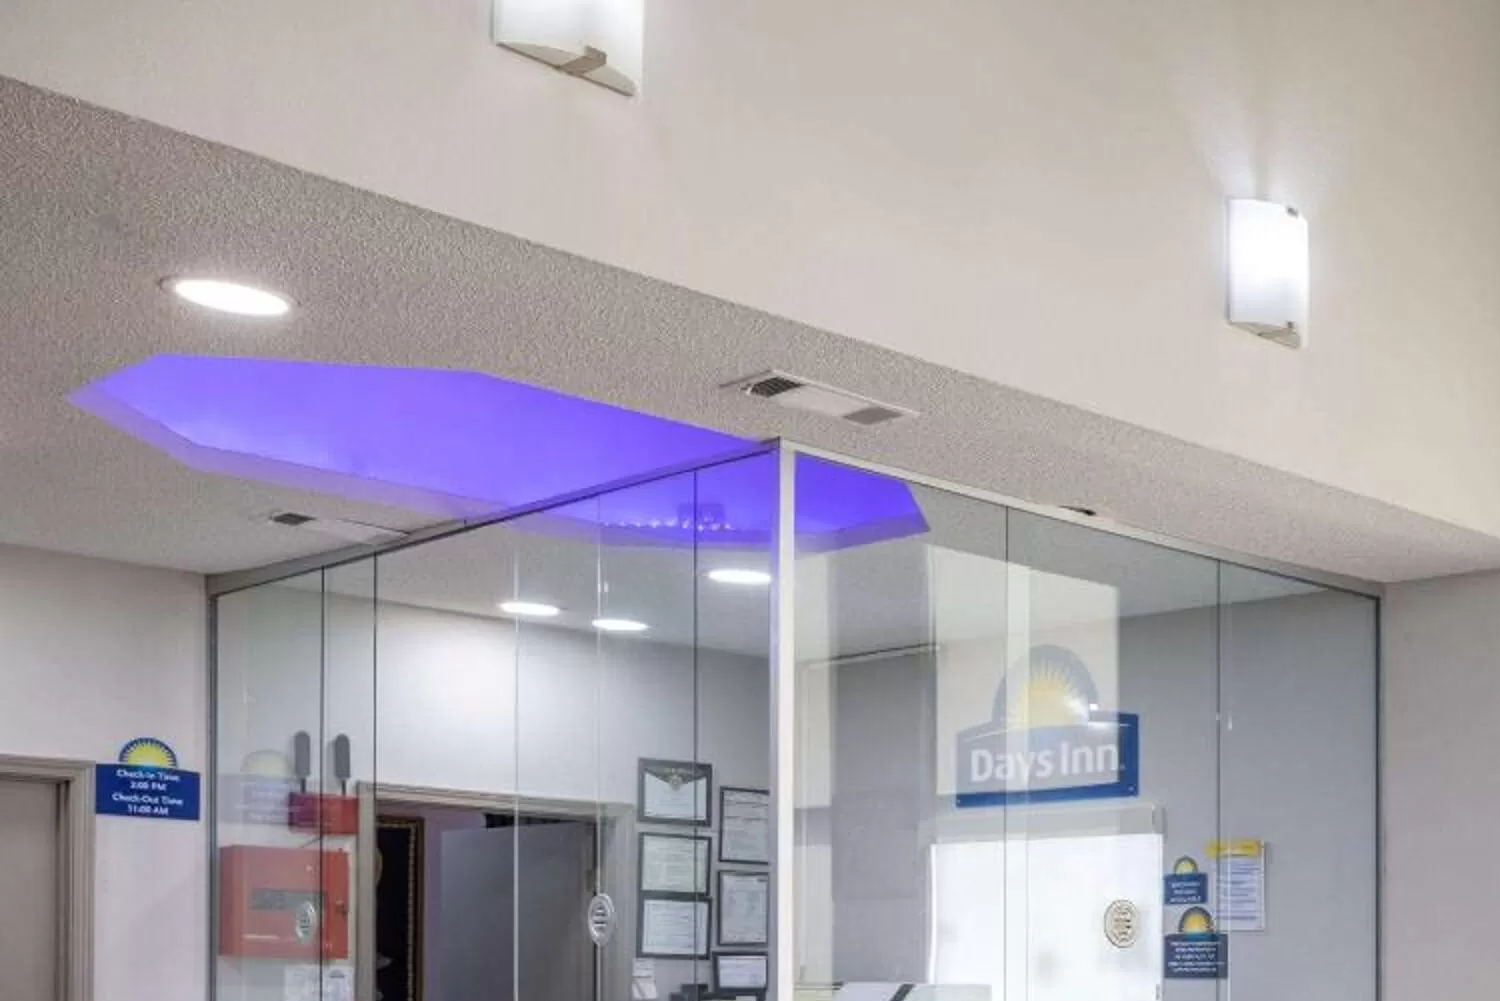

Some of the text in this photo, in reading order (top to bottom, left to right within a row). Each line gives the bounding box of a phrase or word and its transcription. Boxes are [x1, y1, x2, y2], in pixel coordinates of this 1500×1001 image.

[970, 740, 1118, 785] Days Inn
[151, 782, 168, 792] PM
[153, 805, 169, 816] AM
